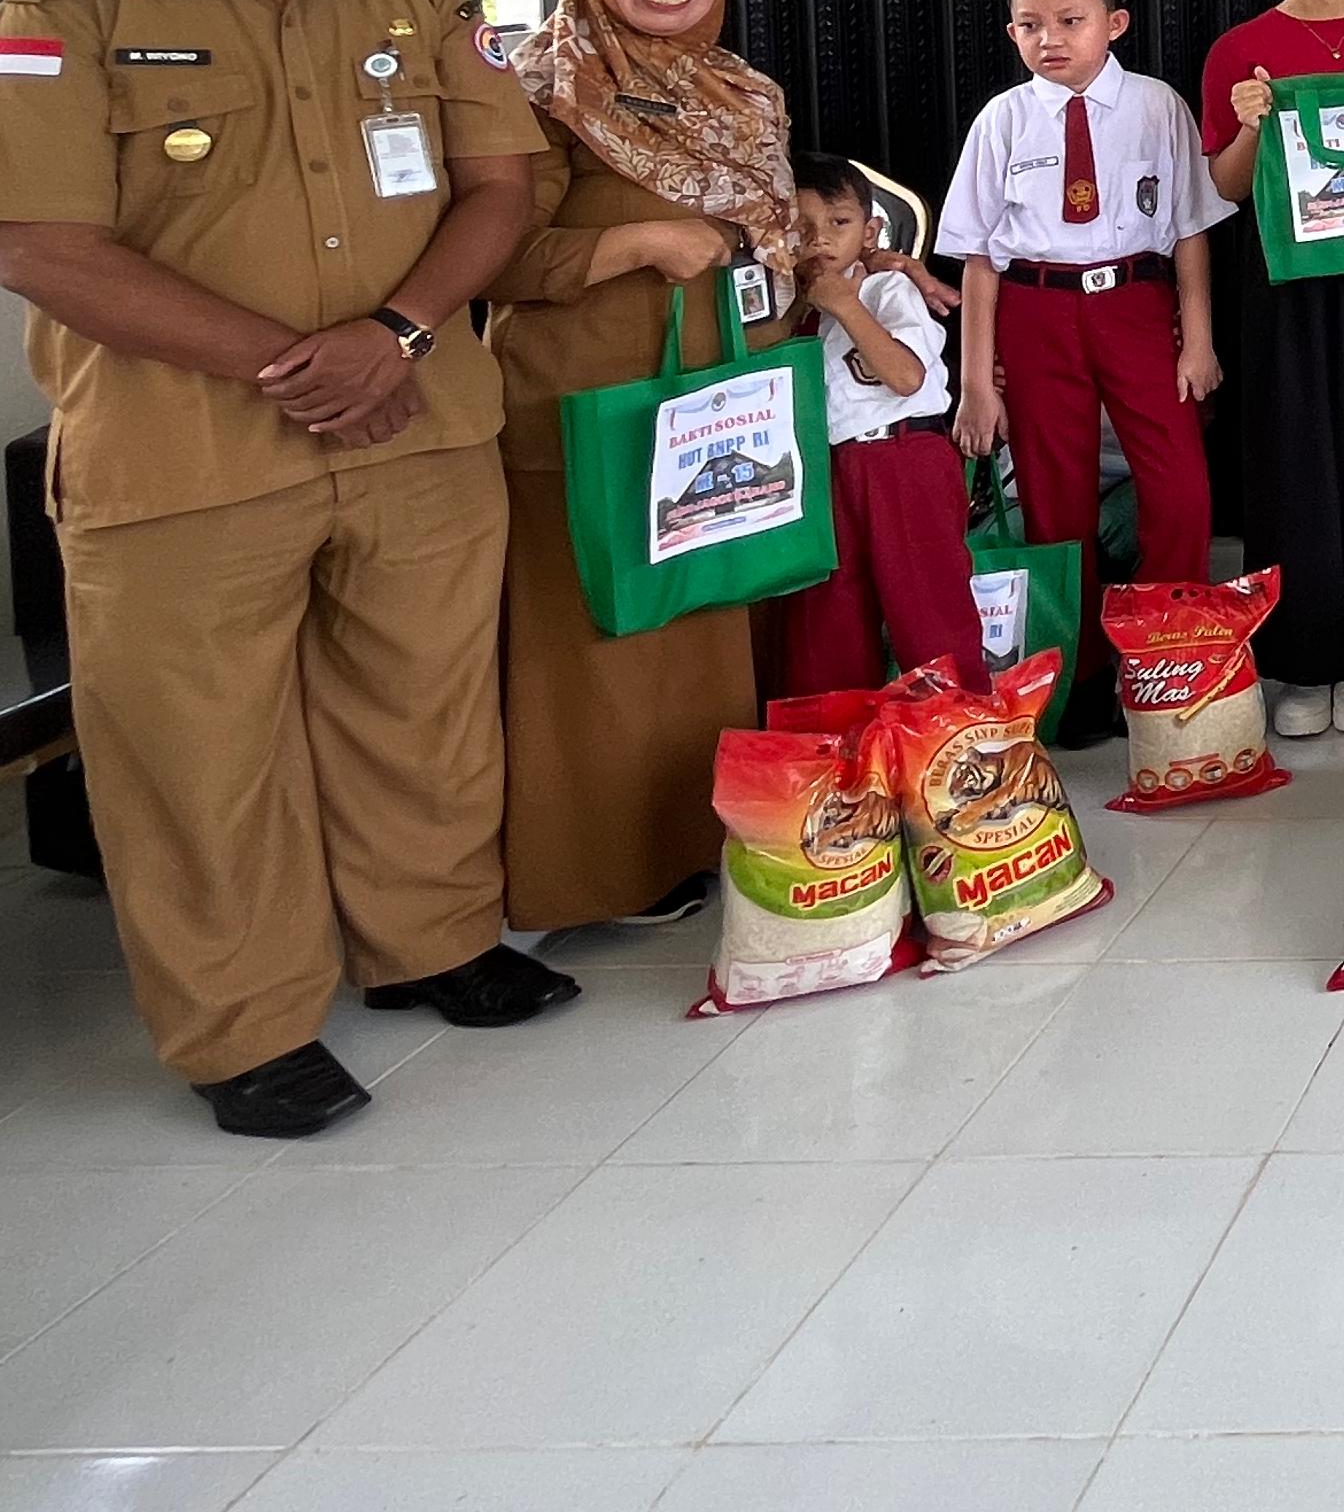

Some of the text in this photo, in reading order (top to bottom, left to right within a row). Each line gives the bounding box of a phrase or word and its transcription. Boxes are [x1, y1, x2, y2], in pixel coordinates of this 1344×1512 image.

[668, 408, 777, 449] BAKTI SOSIAL
[678, 447, 703, 470] HUT
[1125, 657, 1206, 683] Suling
[1132, 679, 1197, 705] Mas
[965, 726, 999, 744] SLYP
[975, 816, 1037, 845] SPESIAL
